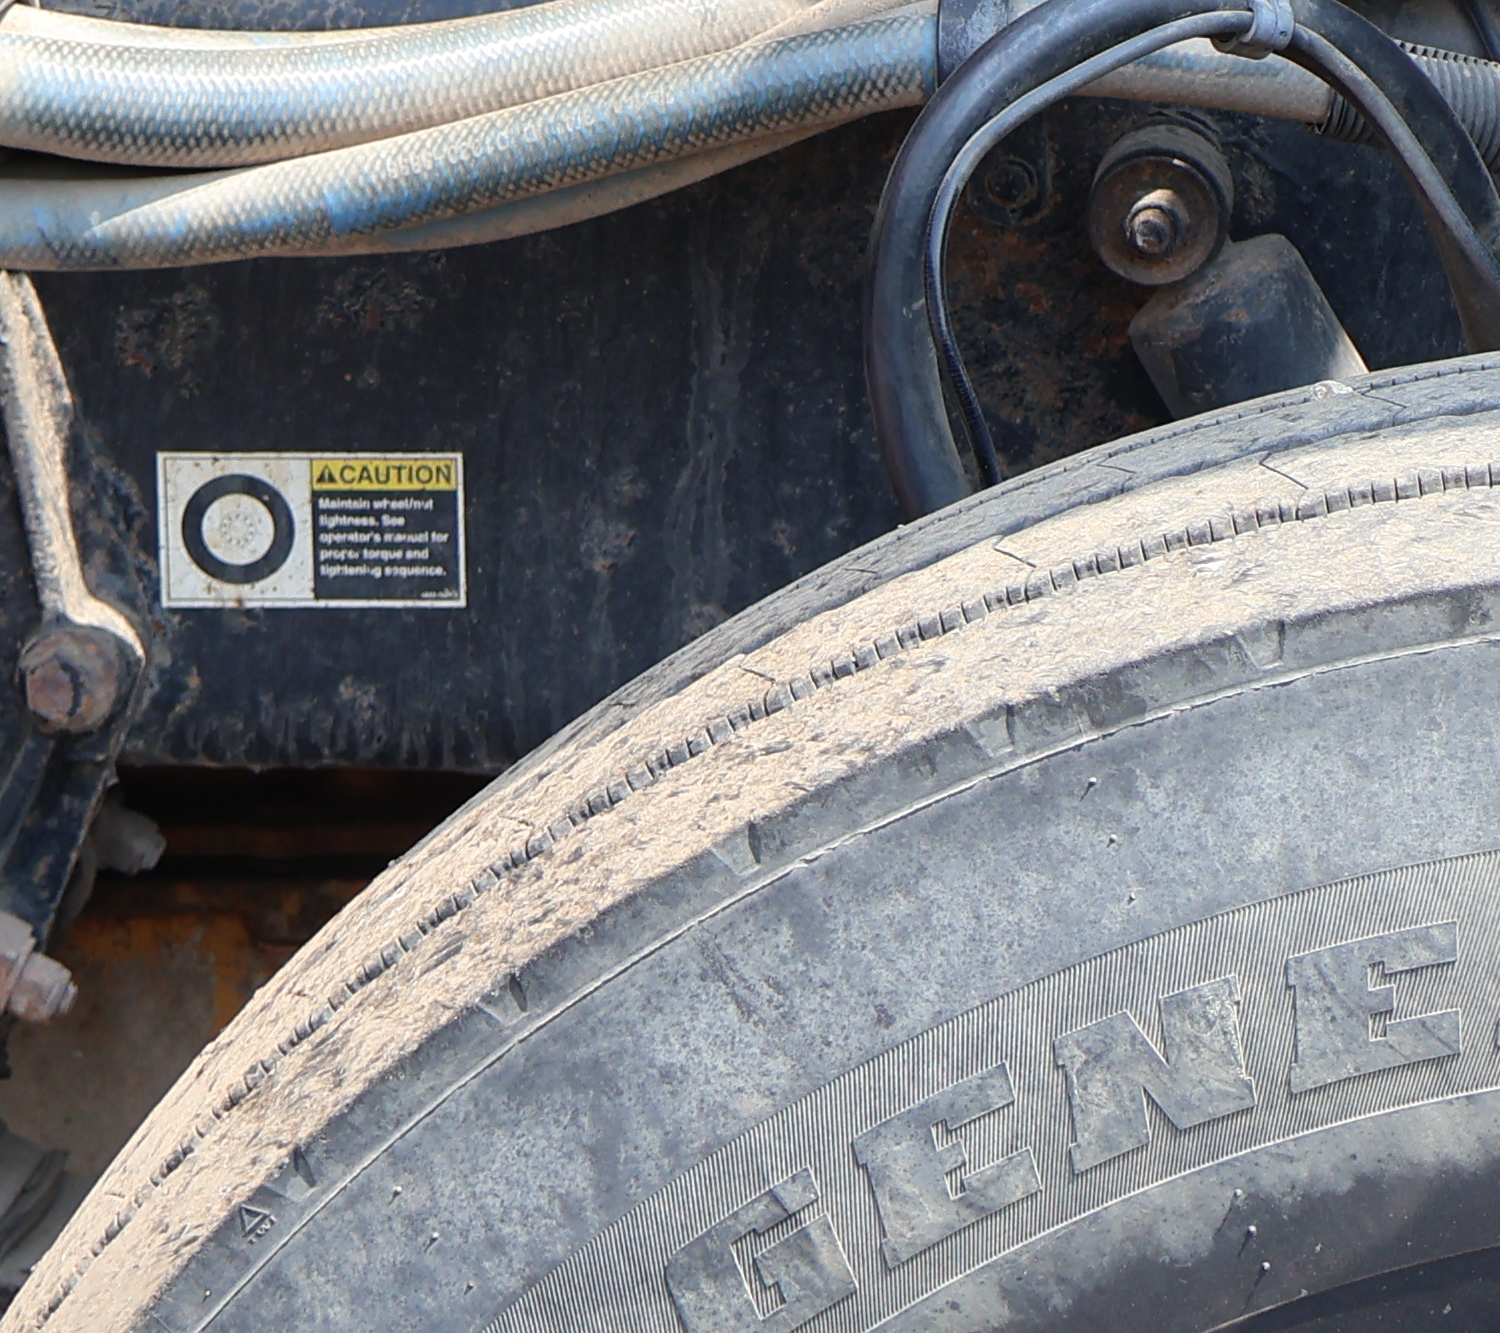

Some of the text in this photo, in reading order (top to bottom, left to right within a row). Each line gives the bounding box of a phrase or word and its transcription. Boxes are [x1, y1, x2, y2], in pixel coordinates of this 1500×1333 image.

[340, 464, 452, 485] CAUTION
[319, 497, 371, 510] Maintain
[319, 513, 405, 529] tightness. See
[319, 531, 450, 545] operator's manual for
[362, 548, 403, 562] torque
[405, 548, 429, 560] and
